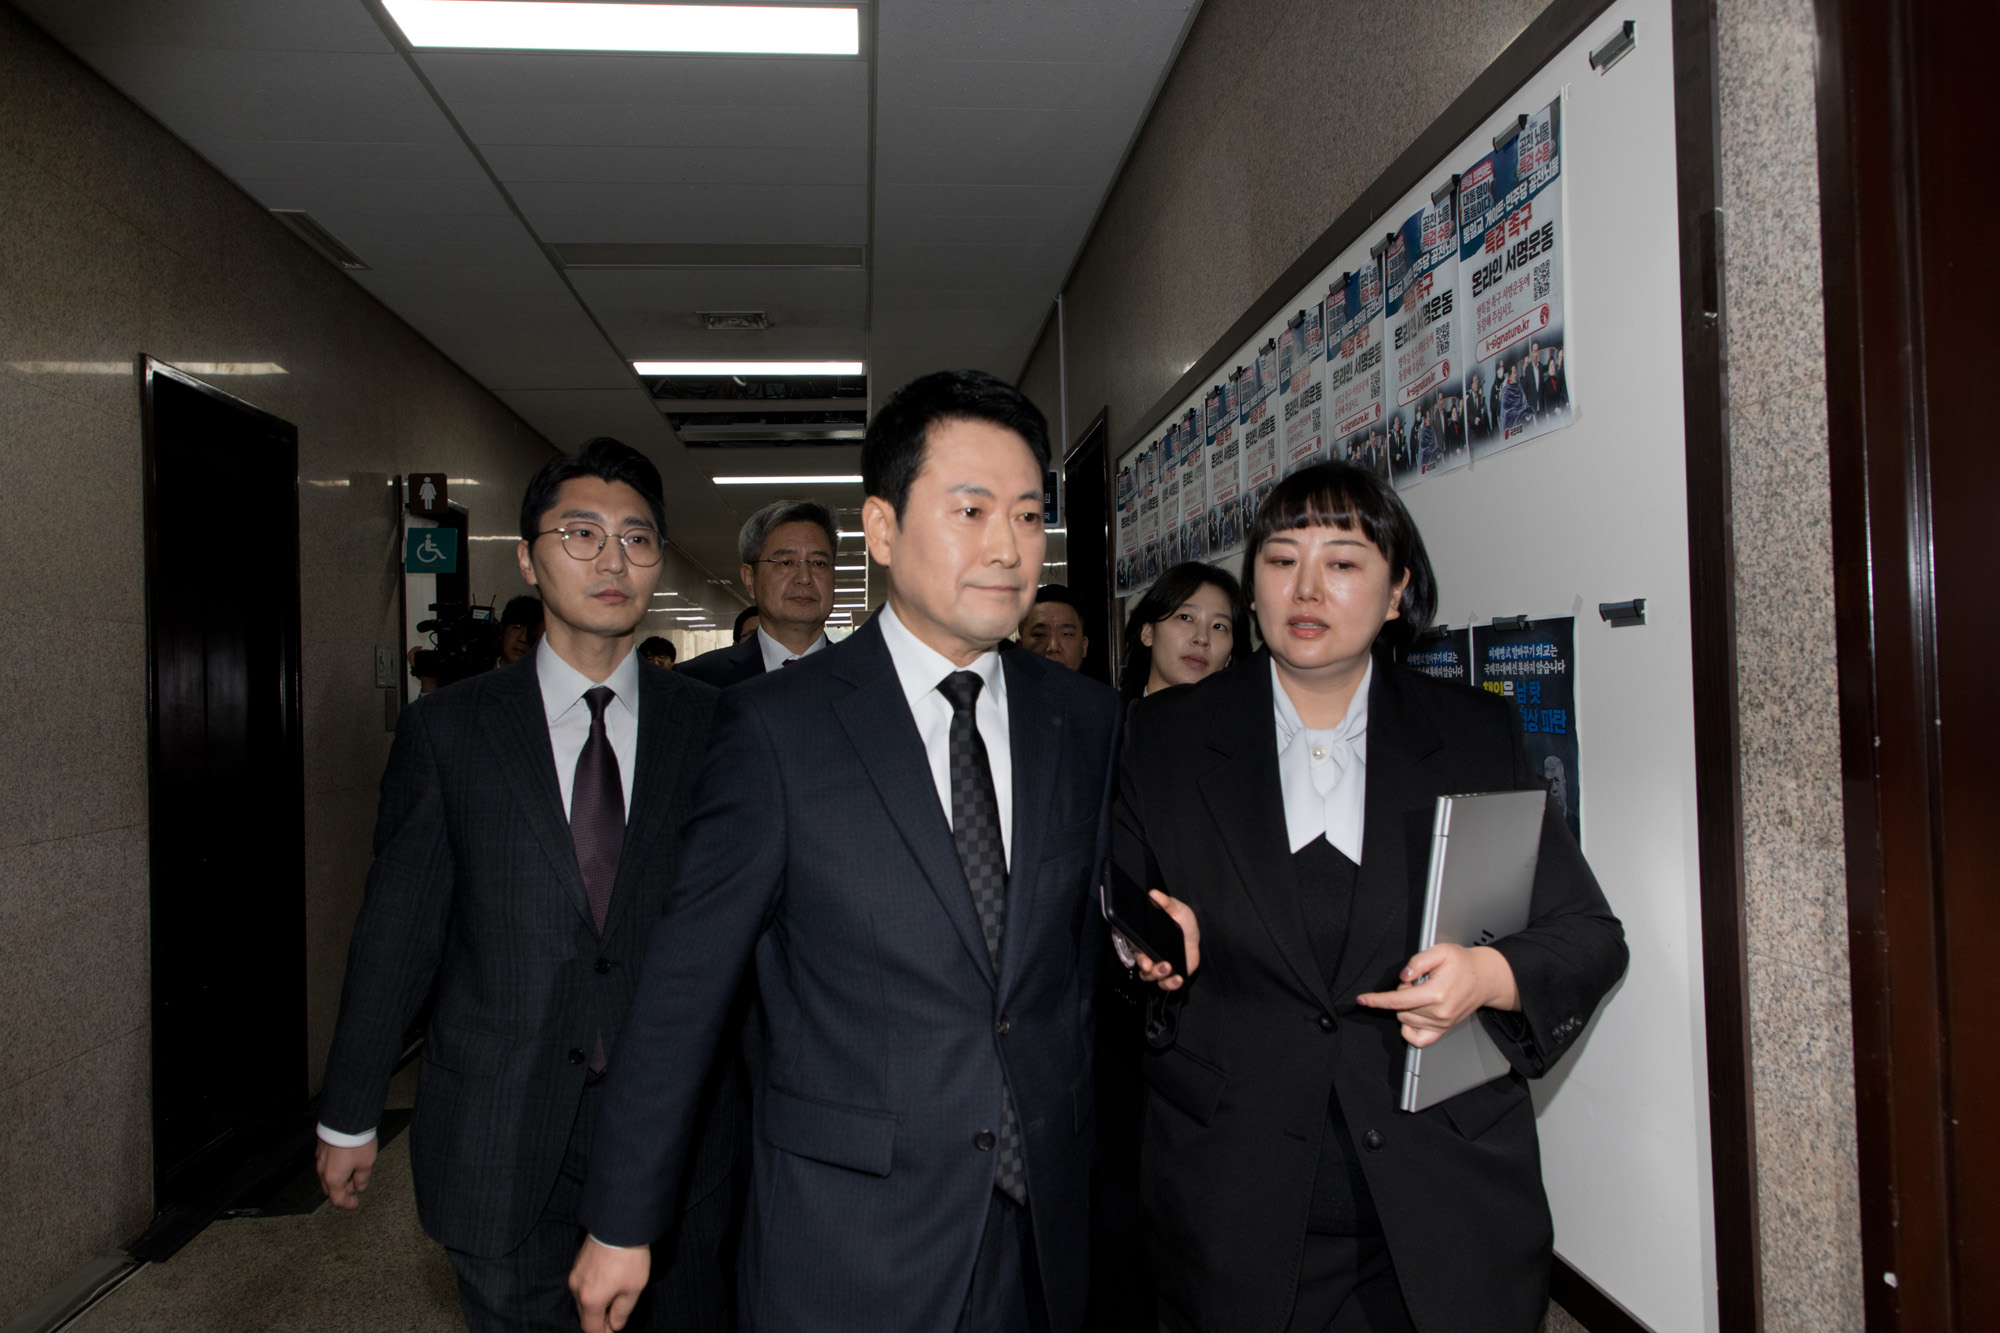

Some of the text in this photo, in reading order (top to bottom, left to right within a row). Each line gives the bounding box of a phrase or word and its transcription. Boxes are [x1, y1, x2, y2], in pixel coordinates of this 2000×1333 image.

[1519, 121, 1550, 156] 공천 뇌물
[1519, 142, 1550, 177] 특검 수용
[1463, 179, 1491, 207] 대통령이
[1463, 215, 1485, 244] 통일교
[1529, 155, 1559, 195] 공천뇌물
[1422, 212, 1437, 232] 공천
[1463, 197, 1491, 221] 몸통이다
[1485, 202, 1532, 255] 특검 촉구
[1472, 220, 1553, 298] 온라인 서명운동
[1416, 271, 1434, 300] 촉구
[1341, 324, 1370, 360] 특검 촉구
[1485, 319, 1530, 352] k-signature.kr
[1333, 361, 1353, 391] 온라인
[1354, 341, 1382, 377] 서명운동
[1536, 643, 1558, 658] 외교는
[1518, 660, 1536, 675] 통하지
[1536, 659, 1566, 674] 않습니다
[1516, 680, 1542, 704] 남탓
[1541, 709, 1567, 735] 파탄
